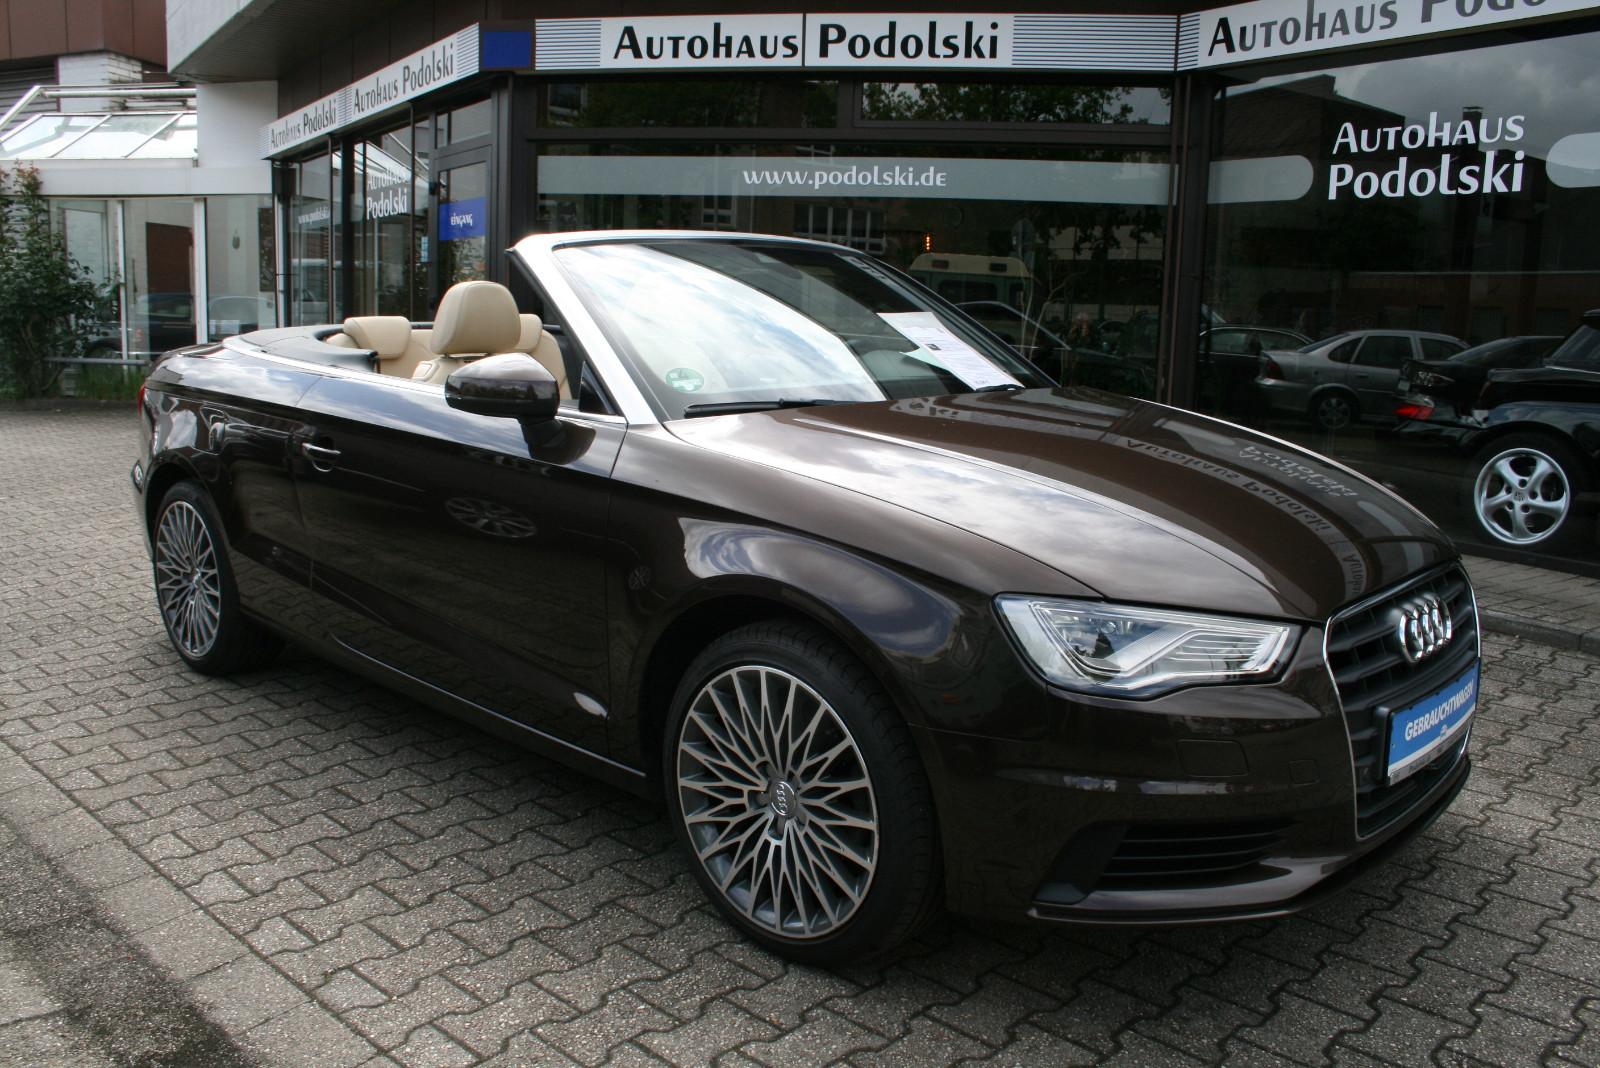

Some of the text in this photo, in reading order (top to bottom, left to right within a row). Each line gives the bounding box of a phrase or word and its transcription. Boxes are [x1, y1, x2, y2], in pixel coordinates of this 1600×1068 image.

[818, 21, 999, 60] Podolski
[402, 42, 454, 94] Podolski
[303, 100, 337, 136] Podolski
[743, 165, 947, 190] www.podolski.de
[1328, 150, 1525, 200] Podolski
[366, 187, 407, 220] Podolski
[1405, 678, 1473, 741] GEBRAUCHTWAGEN
